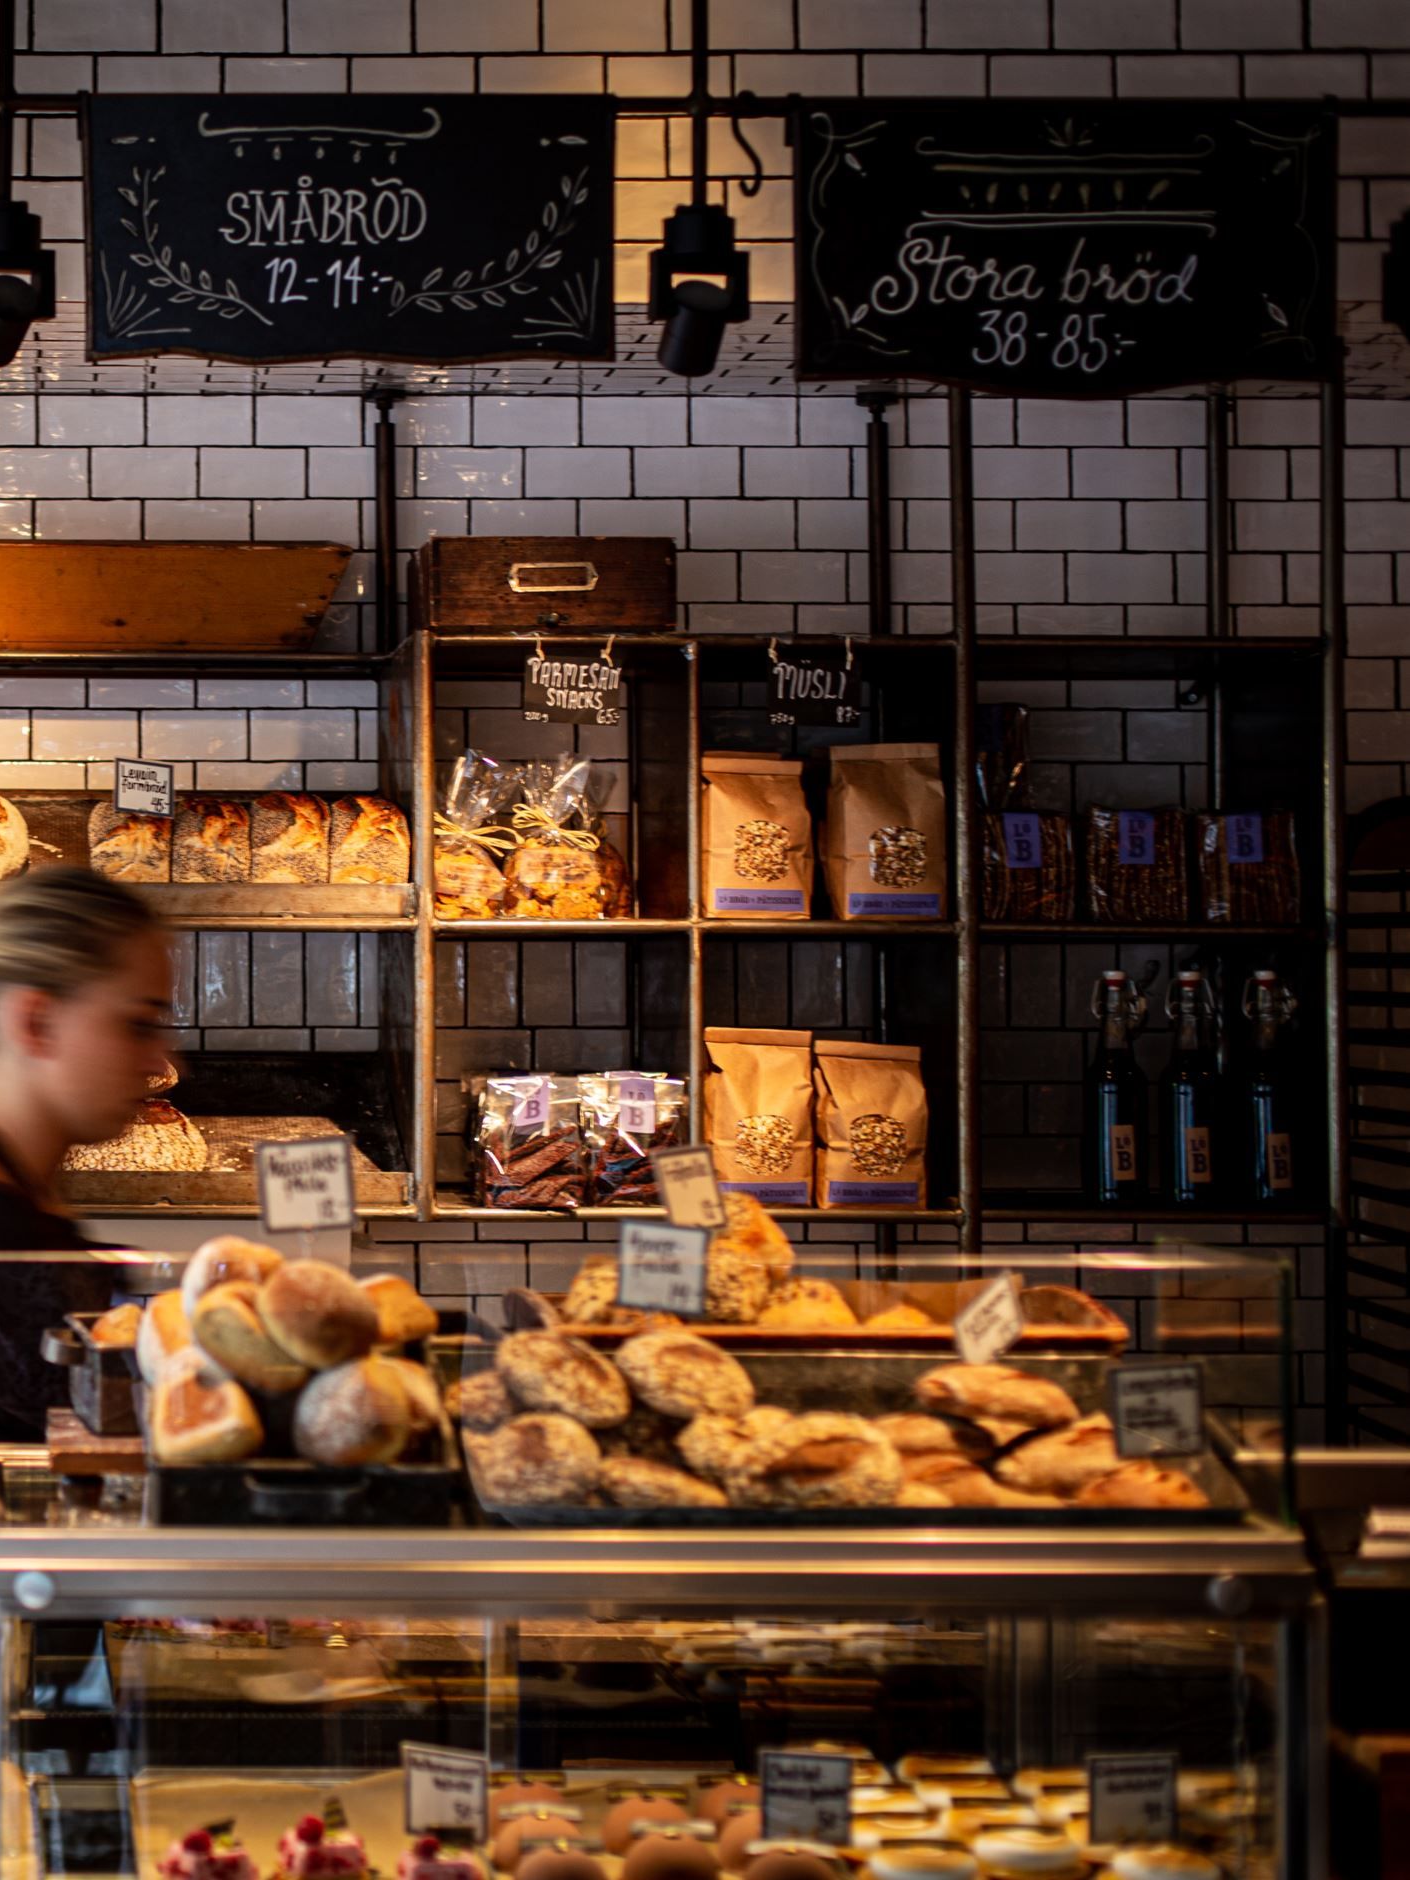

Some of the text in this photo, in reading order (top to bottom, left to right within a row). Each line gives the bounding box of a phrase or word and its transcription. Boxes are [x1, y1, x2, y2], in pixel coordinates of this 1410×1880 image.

[219, 176, 427, 245] SMÅBRÖD
[871, 235, 1198, 314] Stora bröd
[526, 657, 622, 690] PARMESAN
[773, 659, 847, 699] MÜSLI
[546, 688, 604, 711] SNACKS
[525, 1099, 541, 1119] B
[629, 1107, 643, 1126] B
[1117, 1151, 1133, 1172] B
[1192, 1153, 1208, 1173] B
[1274, 1159, 1290, 1180] B
